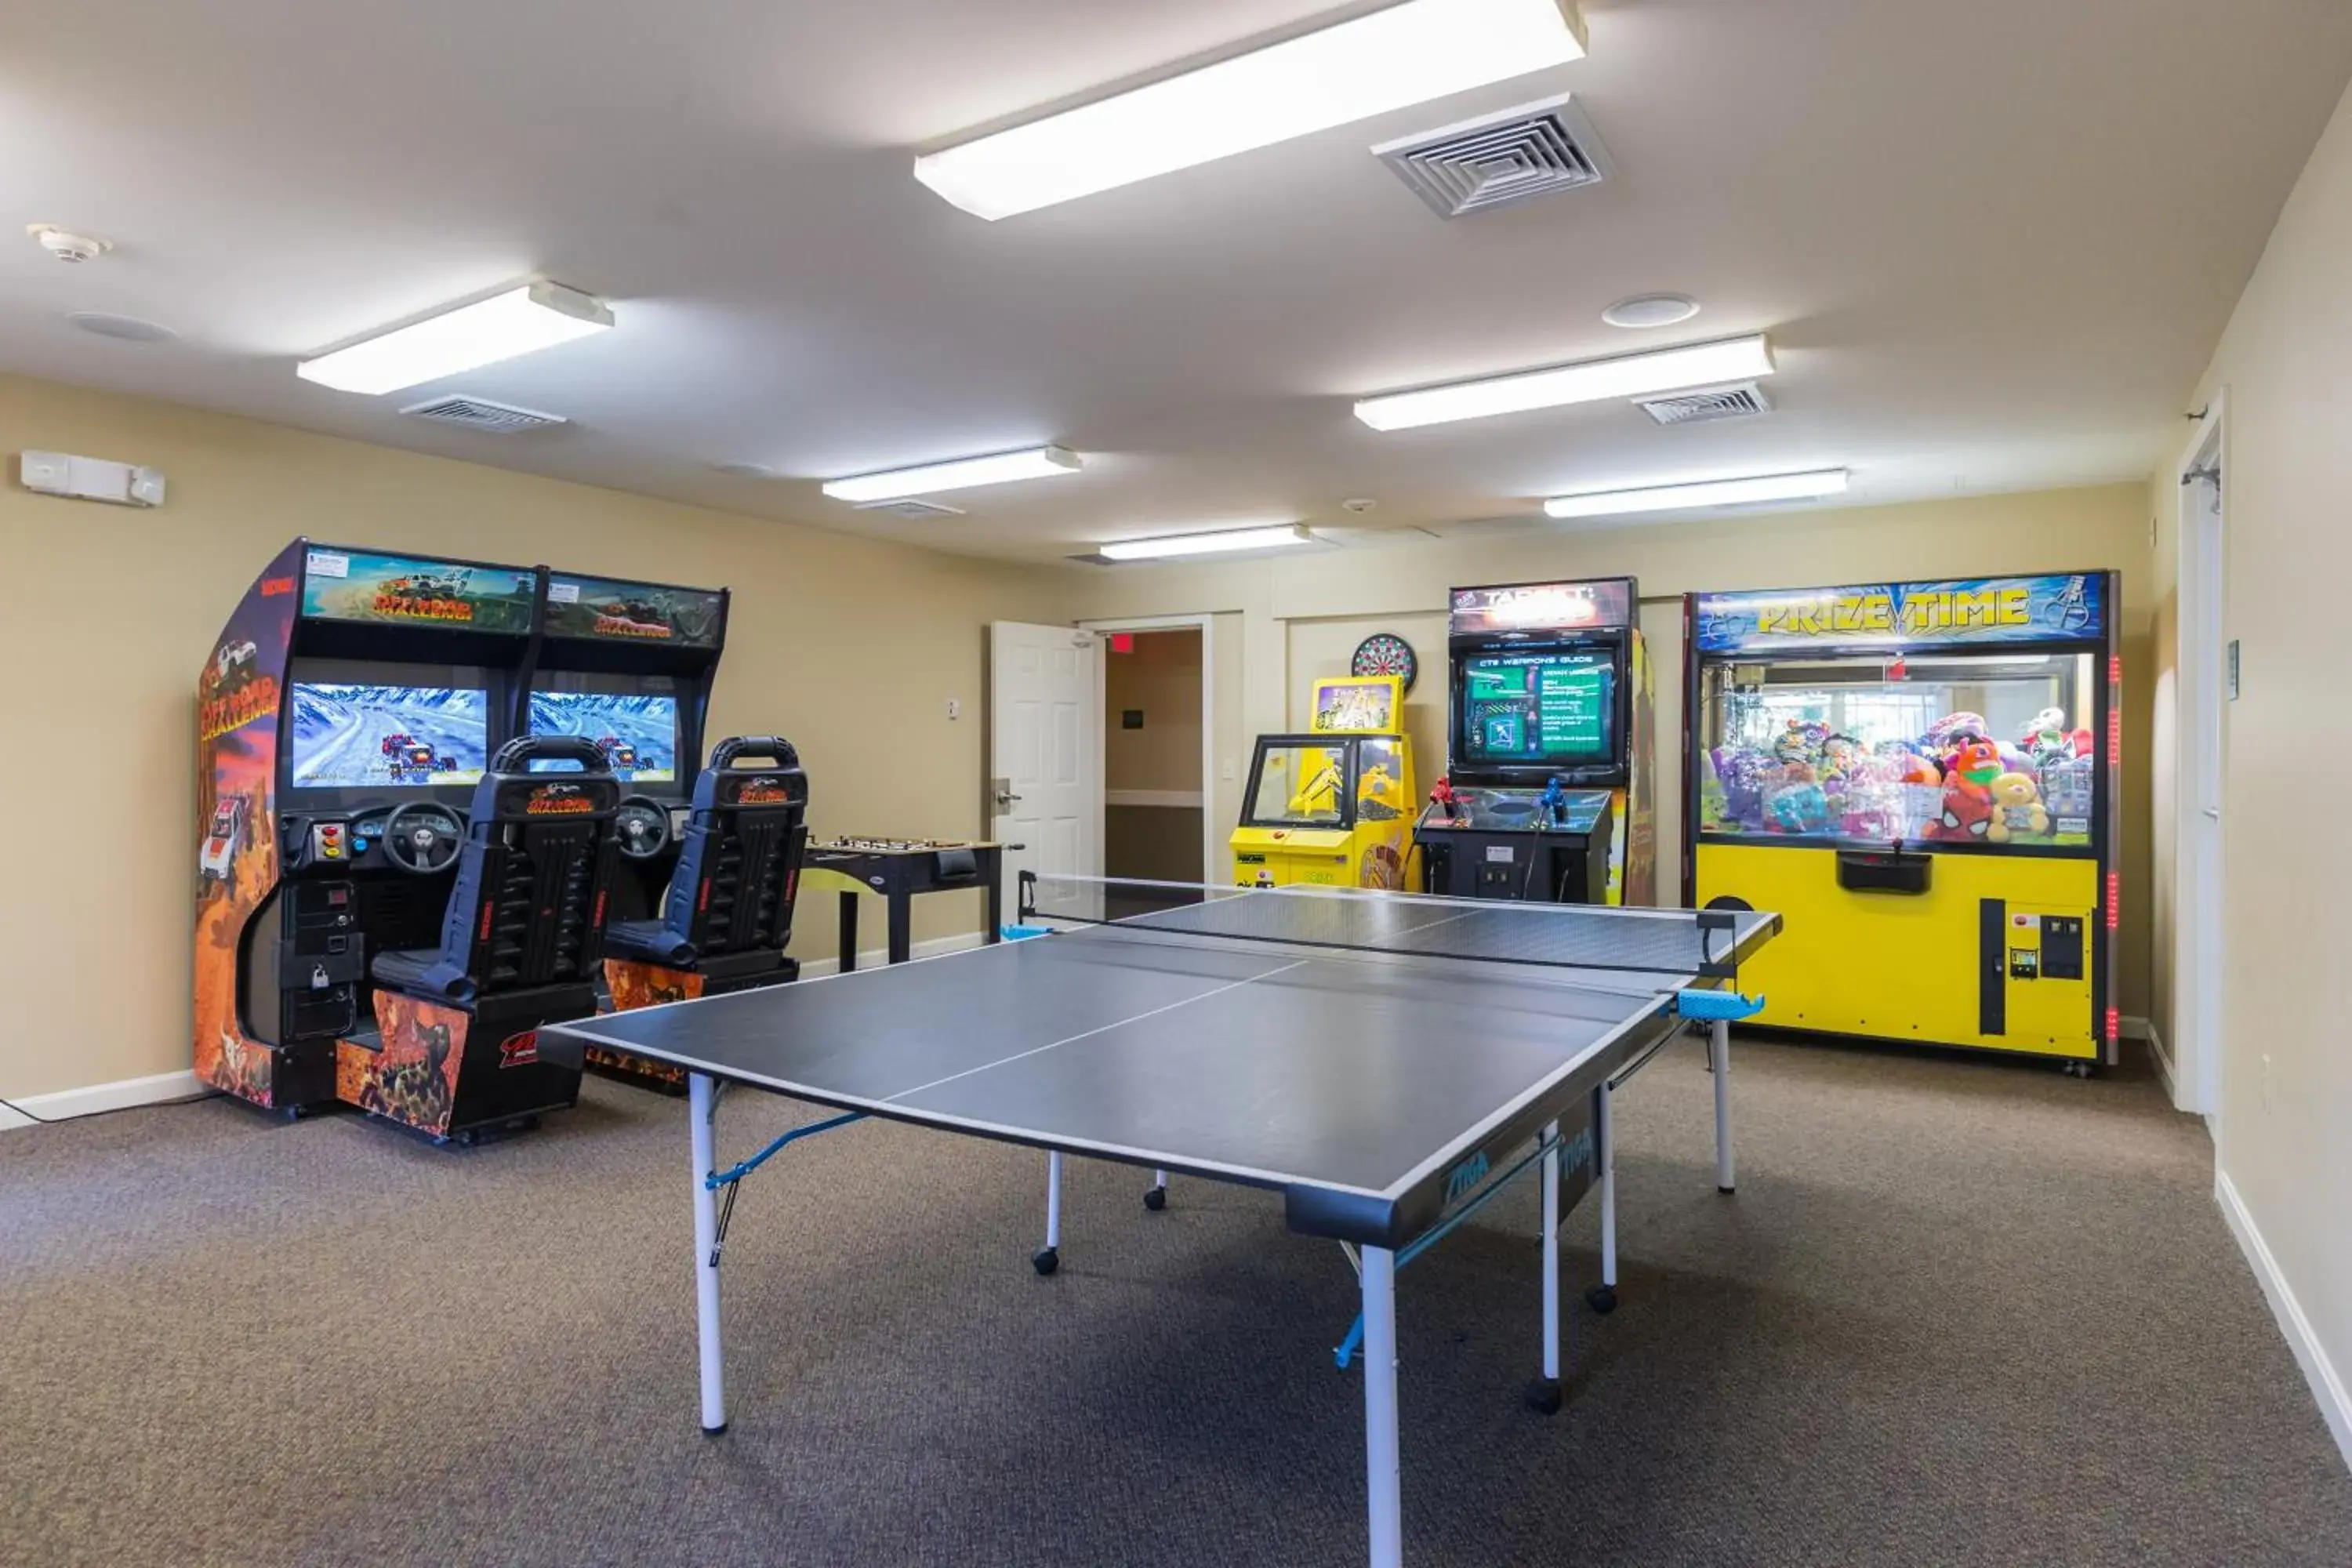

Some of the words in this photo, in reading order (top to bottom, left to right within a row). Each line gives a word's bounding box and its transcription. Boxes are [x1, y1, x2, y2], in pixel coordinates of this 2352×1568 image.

[1758, 594, 1890, 634] PRIZE
[1904, 589, 2031, 628] TIME
[1503, 657, 1555, 666] WEAPONS
[1559, 655, 1594, 664] GUIDE
